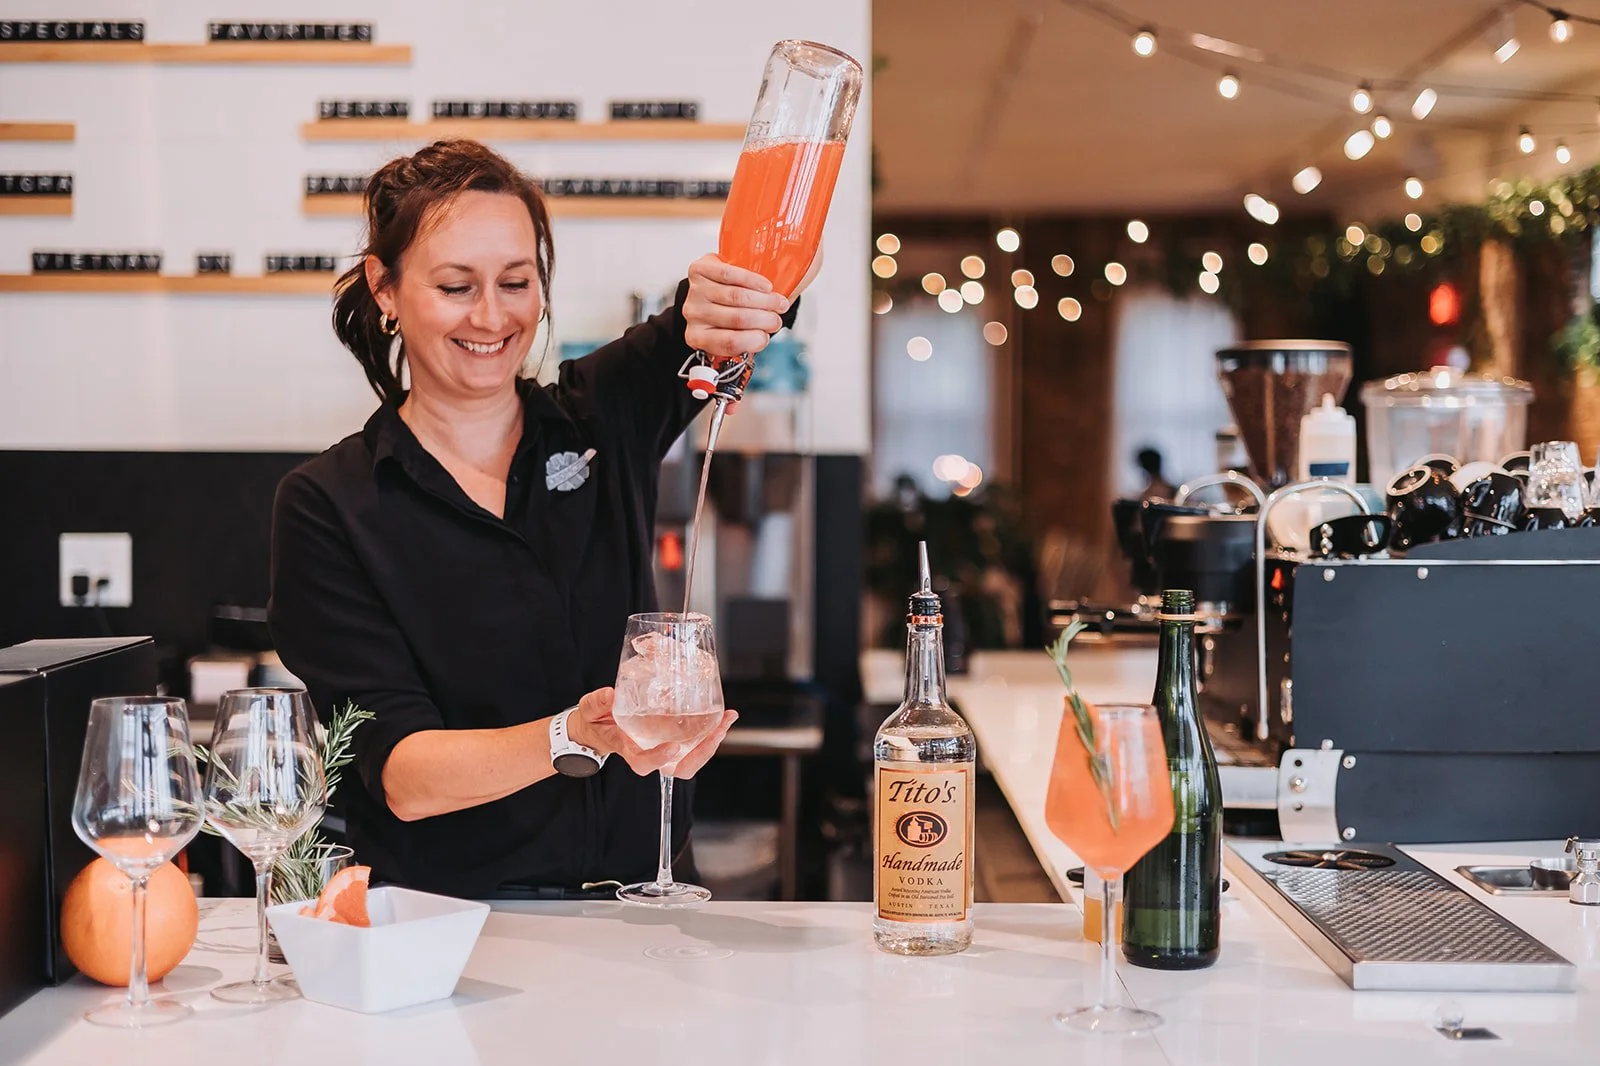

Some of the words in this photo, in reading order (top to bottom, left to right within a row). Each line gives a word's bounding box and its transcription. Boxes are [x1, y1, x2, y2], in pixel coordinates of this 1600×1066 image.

[0, 22, 143, 39] SPECIALS
[210, 23, 371, 41] FAVORITES
[33, 253, 161, 271] VIETNAM
[889, 778, 956, 804] Tito's
[882, 851, 963, 872] Handmade
[899, 876, 943, 886] VODKA
